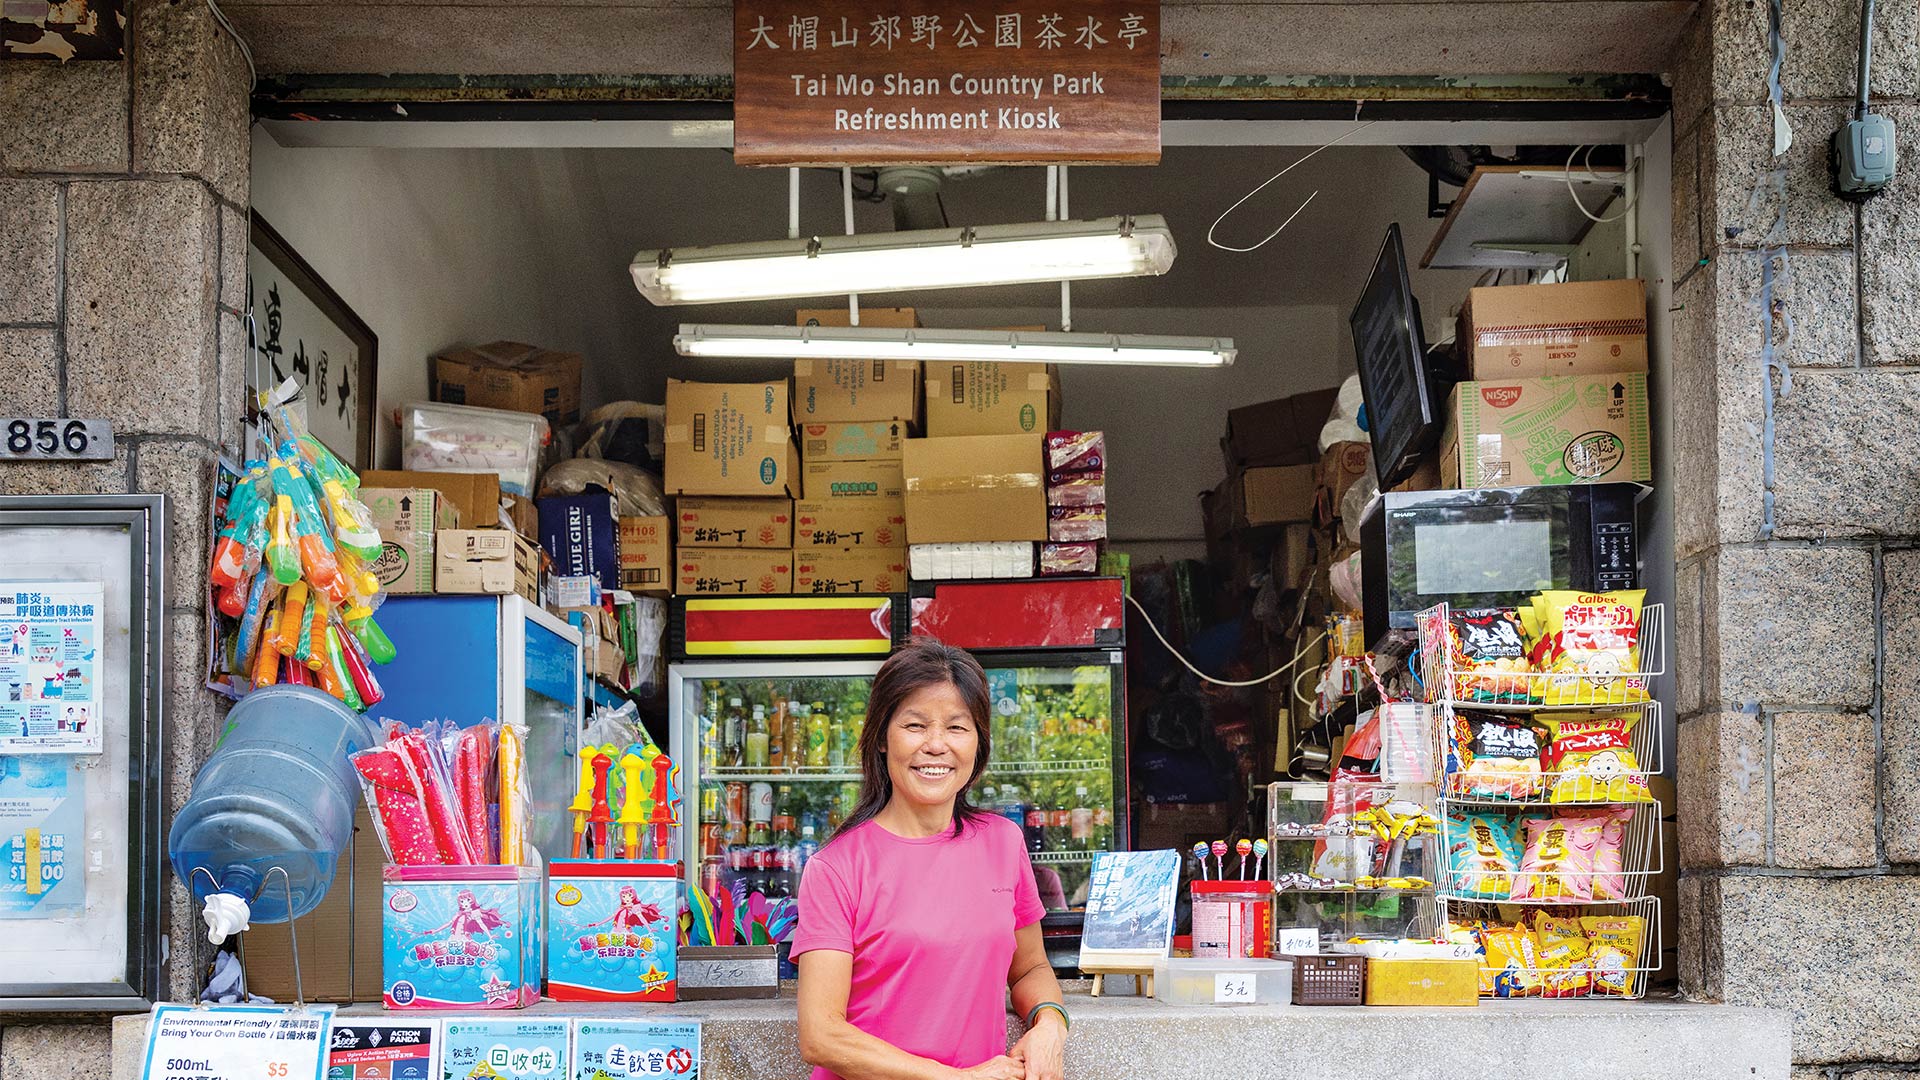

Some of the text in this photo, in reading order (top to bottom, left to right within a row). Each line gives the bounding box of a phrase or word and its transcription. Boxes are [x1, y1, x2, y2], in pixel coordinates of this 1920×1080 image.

[746, 12, 1148, 51] 大帽山郊野公園茶水亭
[791, 72, 1104, 99] Tai Mo Shan Country Park
[835, 106, 1061, 131] Refreshment Kiosk
[765, 386, 775, 415] Calbee
[806, 386, 817, 414] Calbee
[1485, 389, 1519, 400] NISSIN
[8, 419, 88, 454] 856
[622, 526, 656, 537] 21108
[694, 527, 747, 543] 出前一丁
[813, 529, 865, 545] 出前一丁
[571, 544, 584, 577] BLUE
[695, 577, 749, 593] 出前一丁
[812, 578, 864, 593] 出前一丁
[1577, 594, 1618, 604] Calbee
[16, 604, 94, 617] 呼吸道傳染病
[1628, 774, 1648, 789] 55g
[12, 833, 65, 849] 亂垃圾
[10, 864, 65, 881] $100
[162, 1017, 232, 1027] Environmental
[233, 1019, 272, 1029] Friendly
[160, 1028, 187, 1038] Bring
[190, 1029, 213, 1038] Your
[214, 1030, 236, 1038] Own
[237, 1030, 267, 1039] Bottle
[166, 1058, 289, 1078] 500mL $5
[609, 1047, 664, 1073] 走飲管
[584, 1066, 626, 1079] No Straws
